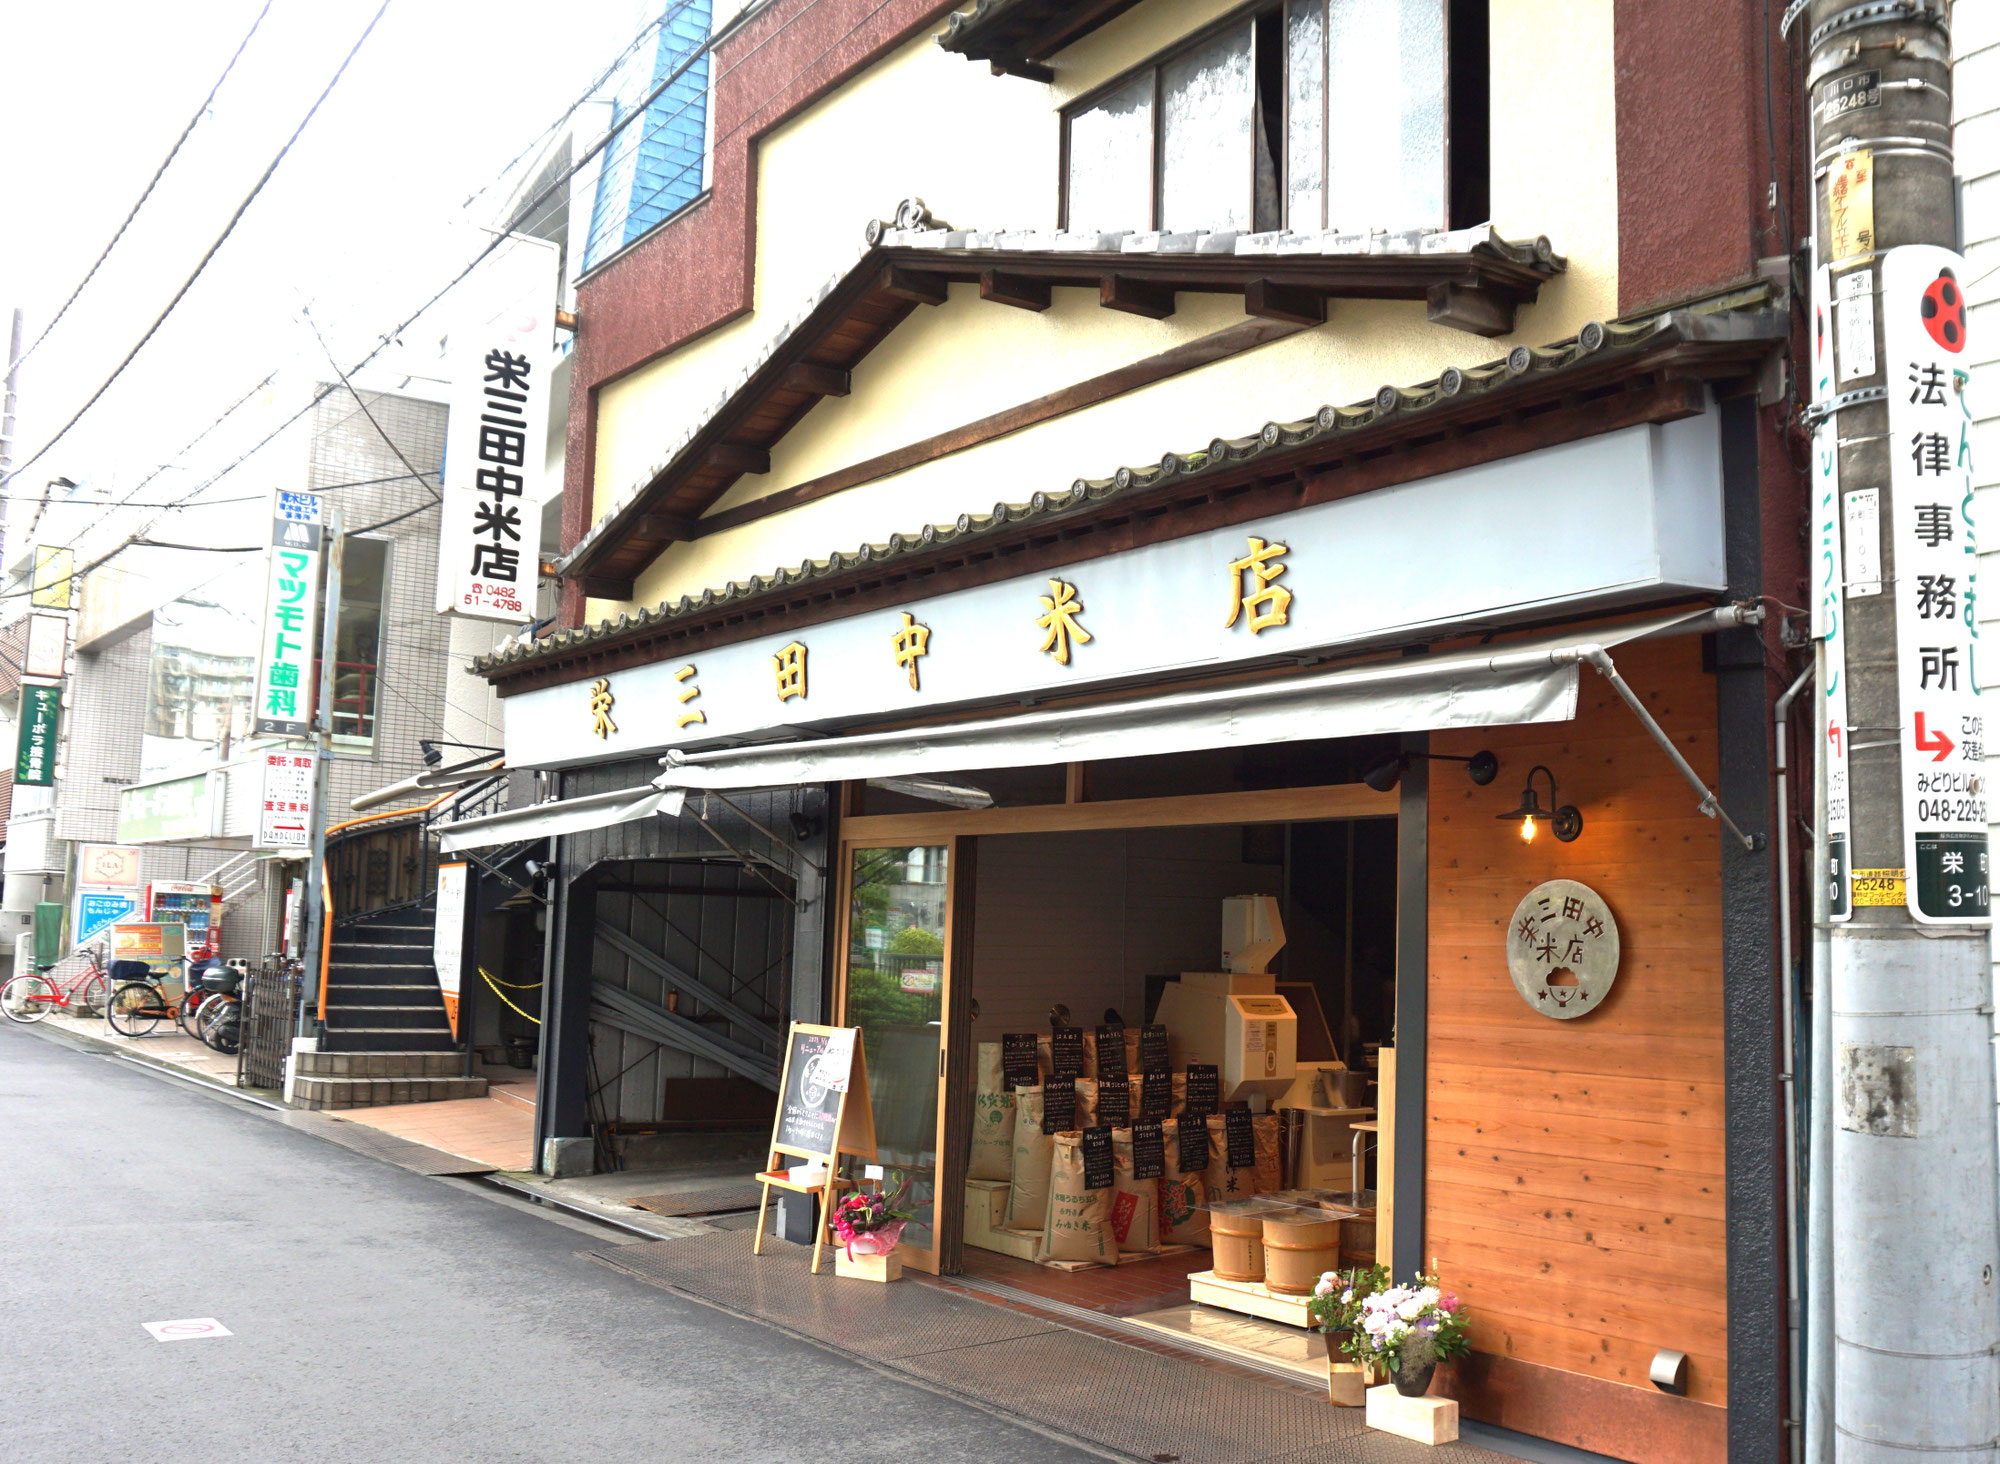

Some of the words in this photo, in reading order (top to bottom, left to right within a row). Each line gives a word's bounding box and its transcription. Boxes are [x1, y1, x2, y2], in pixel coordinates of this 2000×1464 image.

[1825, 90, 1879, 118] 25248号
[1829, 75, 1871, 97] 川口市
[470, 348, 531, 583] 栄三田中米店
[1907, 361, 1960, 692] 法律事務所
[486, 584, 517, 600] 0482
[265, 550, 310, 718] マツモト歯科
[588, 535, 1294, 741] 栄三田中米店
[1855, 878, 1895, 891] 25248
[1518, 896, 1604, 948] 栄三田中
[1536, 931, 1585, 965] 米店
